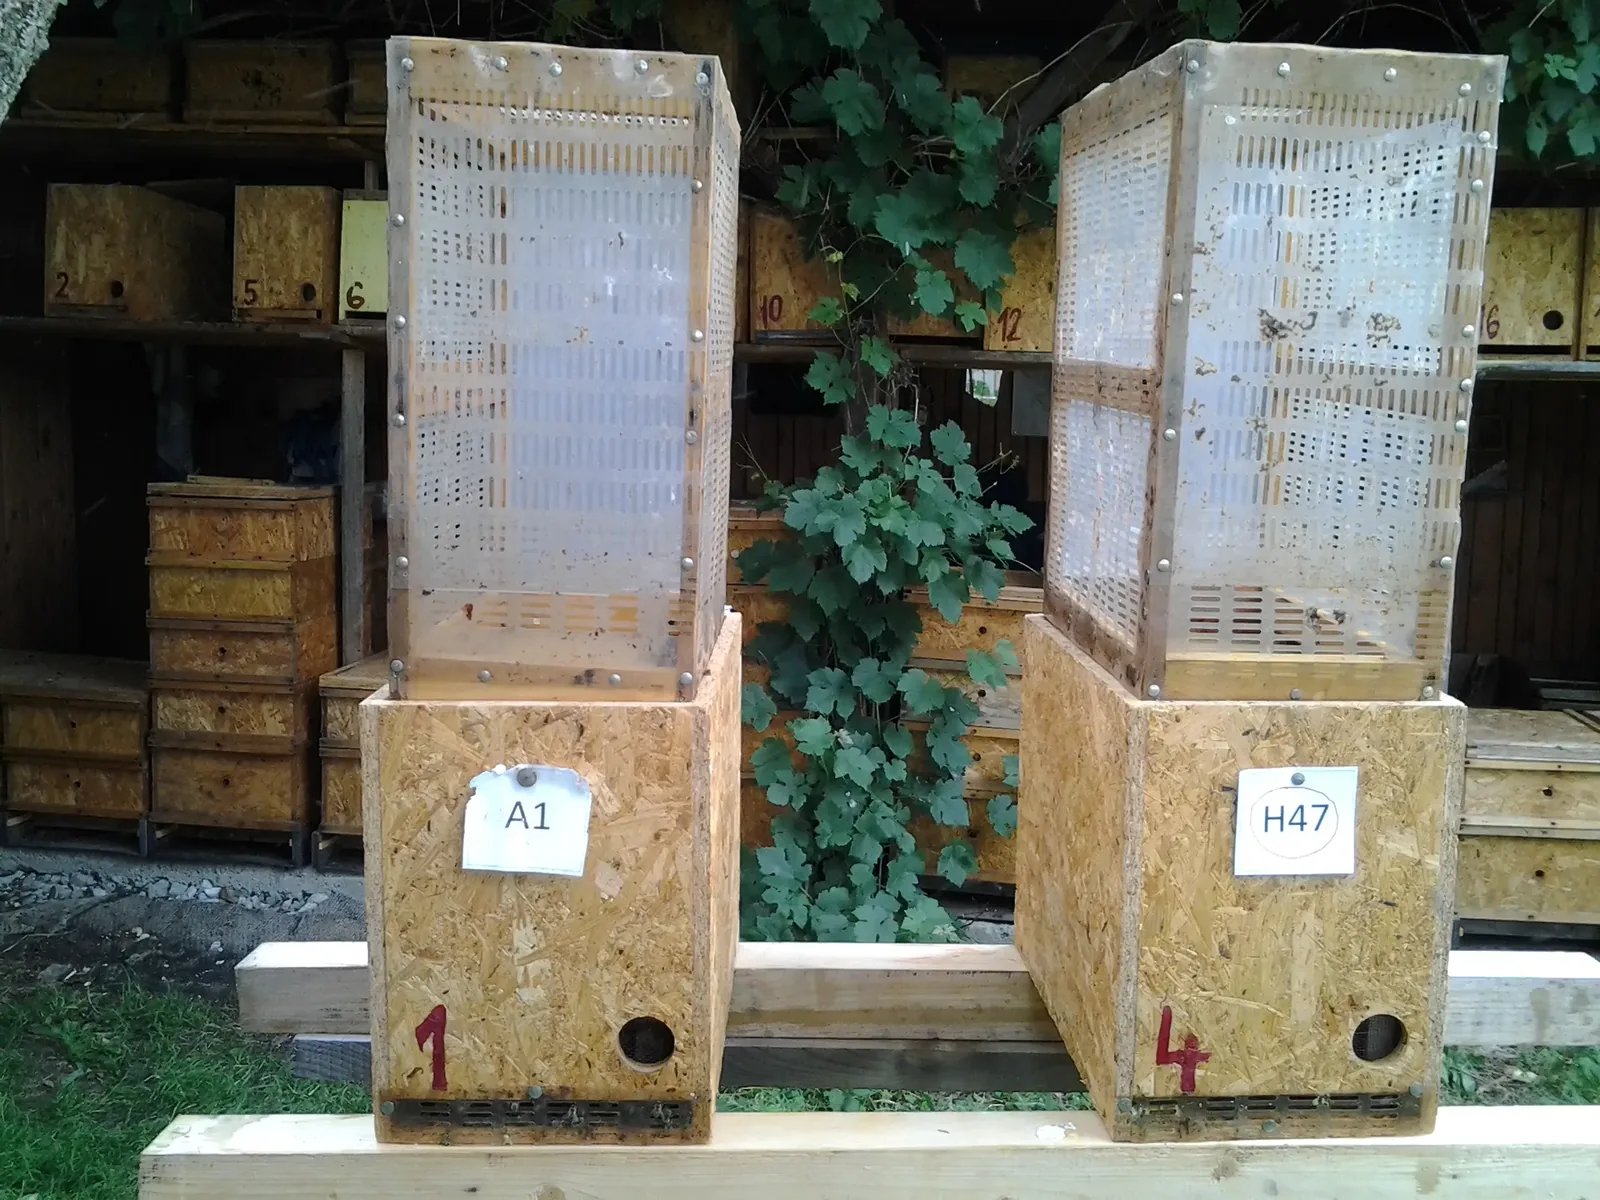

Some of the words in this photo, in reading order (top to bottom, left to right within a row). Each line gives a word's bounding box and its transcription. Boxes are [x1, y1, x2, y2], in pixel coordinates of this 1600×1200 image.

[55, 271, 69, 298] 2
[243, 279, 258, 306] 5
[346, 281, 365, 309] 6
[760, 294, 784, 330] 10
[997, 306, 1021, 341] 12
[504, 800, 551, 830] A1
[1264, 804, 1329, 833] H47
[415, 1004, 448, 1091] 1
[1156, 1005, 1212, 1092] 4
